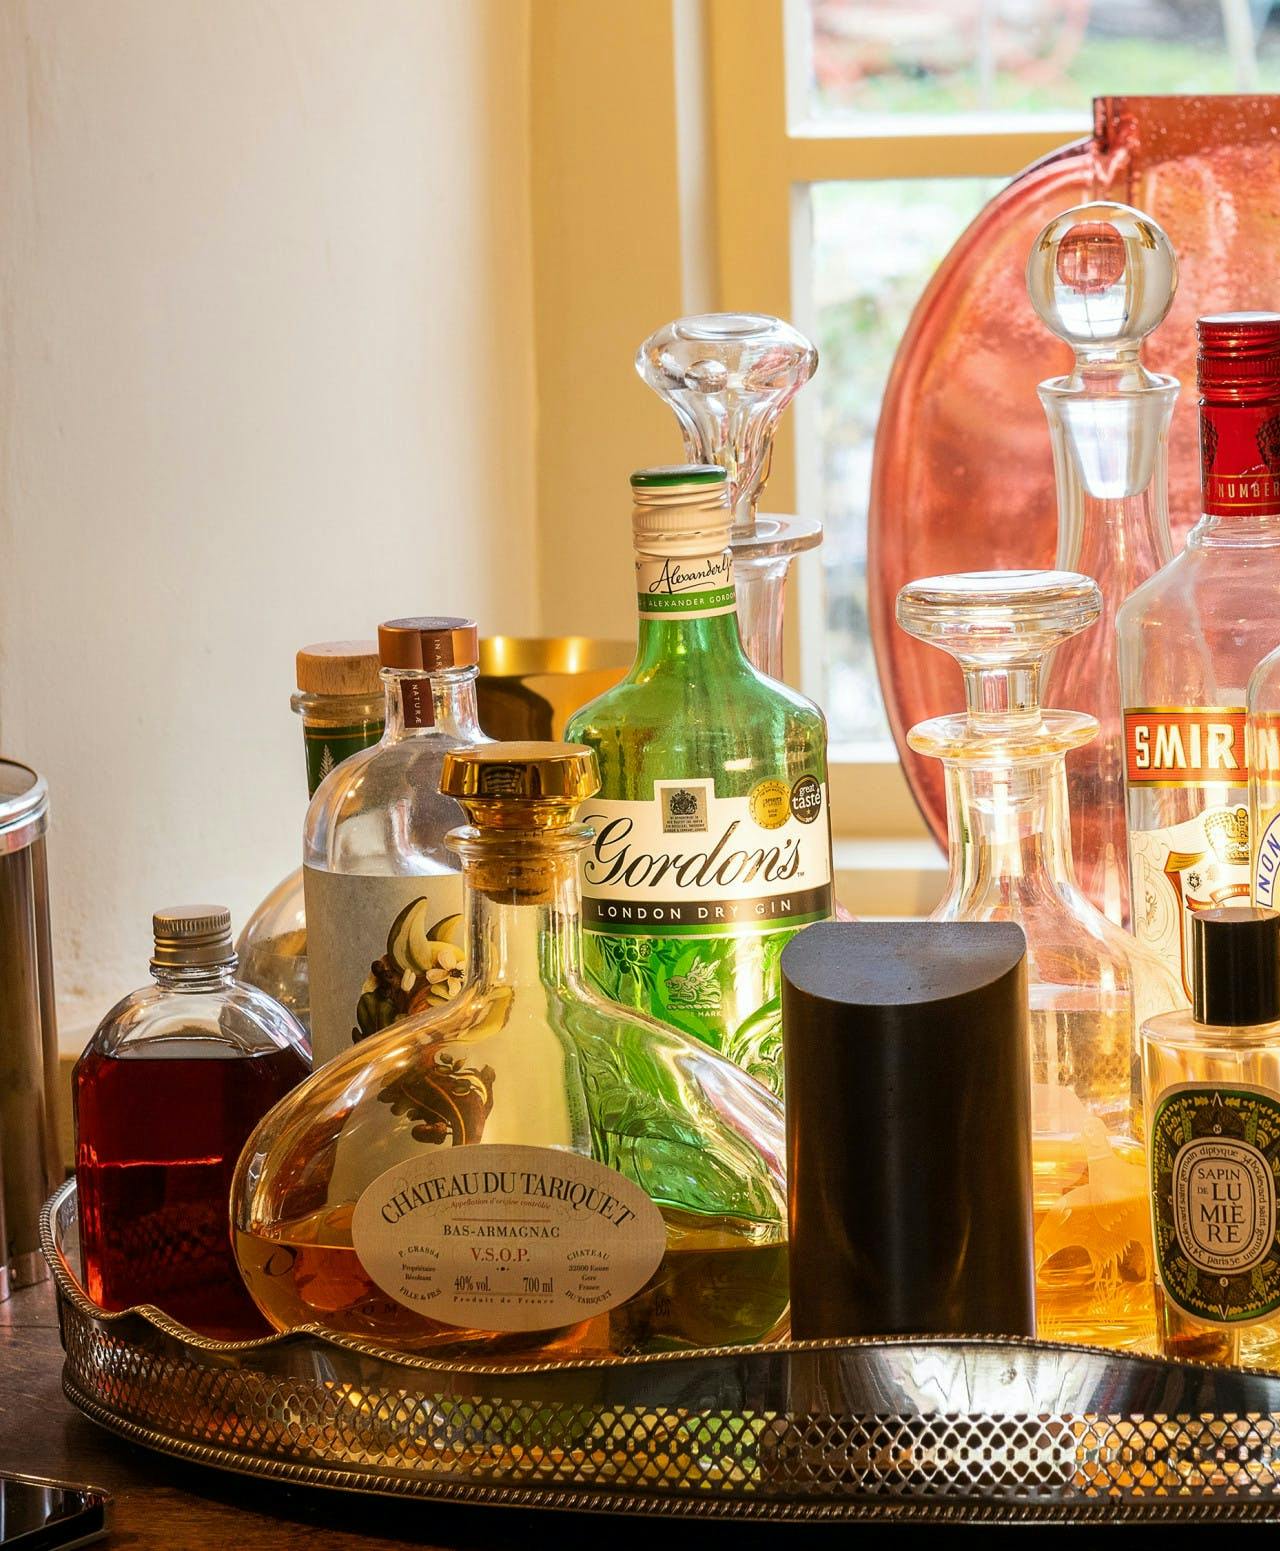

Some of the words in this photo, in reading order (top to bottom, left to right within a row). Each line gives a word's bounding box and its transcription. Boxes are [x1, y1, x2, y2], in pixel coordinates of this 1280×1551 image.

[1218, 481, 1280, 498] NUMBER
[648, 598, 705, 608] ALEXANDER
[800, 784, 815, 797] great
[583, 814, 801, 888] Gordon's
[598, 904, 682, 920] LONDON
[698, 905, 739, 919] DRY
[756, 899, 791, 914] GIN
[1200, 1147, 1239, 1156] diptyque
[1198, 1168, 1240, 1180] SAPIN
[381, 1172, 479, 1224] CHATEAU
[483, 1171, 517, 1194] DU
[521, 1172, 636, 1228] TARIQUET
[1197, 1186, 1208, 1195] DE
[1212, 1182, 1242, 1201] LU
[1200, 1202, 1246, 1224] MIÈ
[443, 1224, 560, 1238] BAS-ARMAGNAC
[1207, 1224, 1242, 1243] RE
[470, 1247, 530, 1262] V.S.O.P.
[454, 1275, 473, 1291] 40%
[476, 1275, 491, 1292] vol.
[523, 1277, 540, 1292] 700
[542, 1277, 553, 1292] ml
